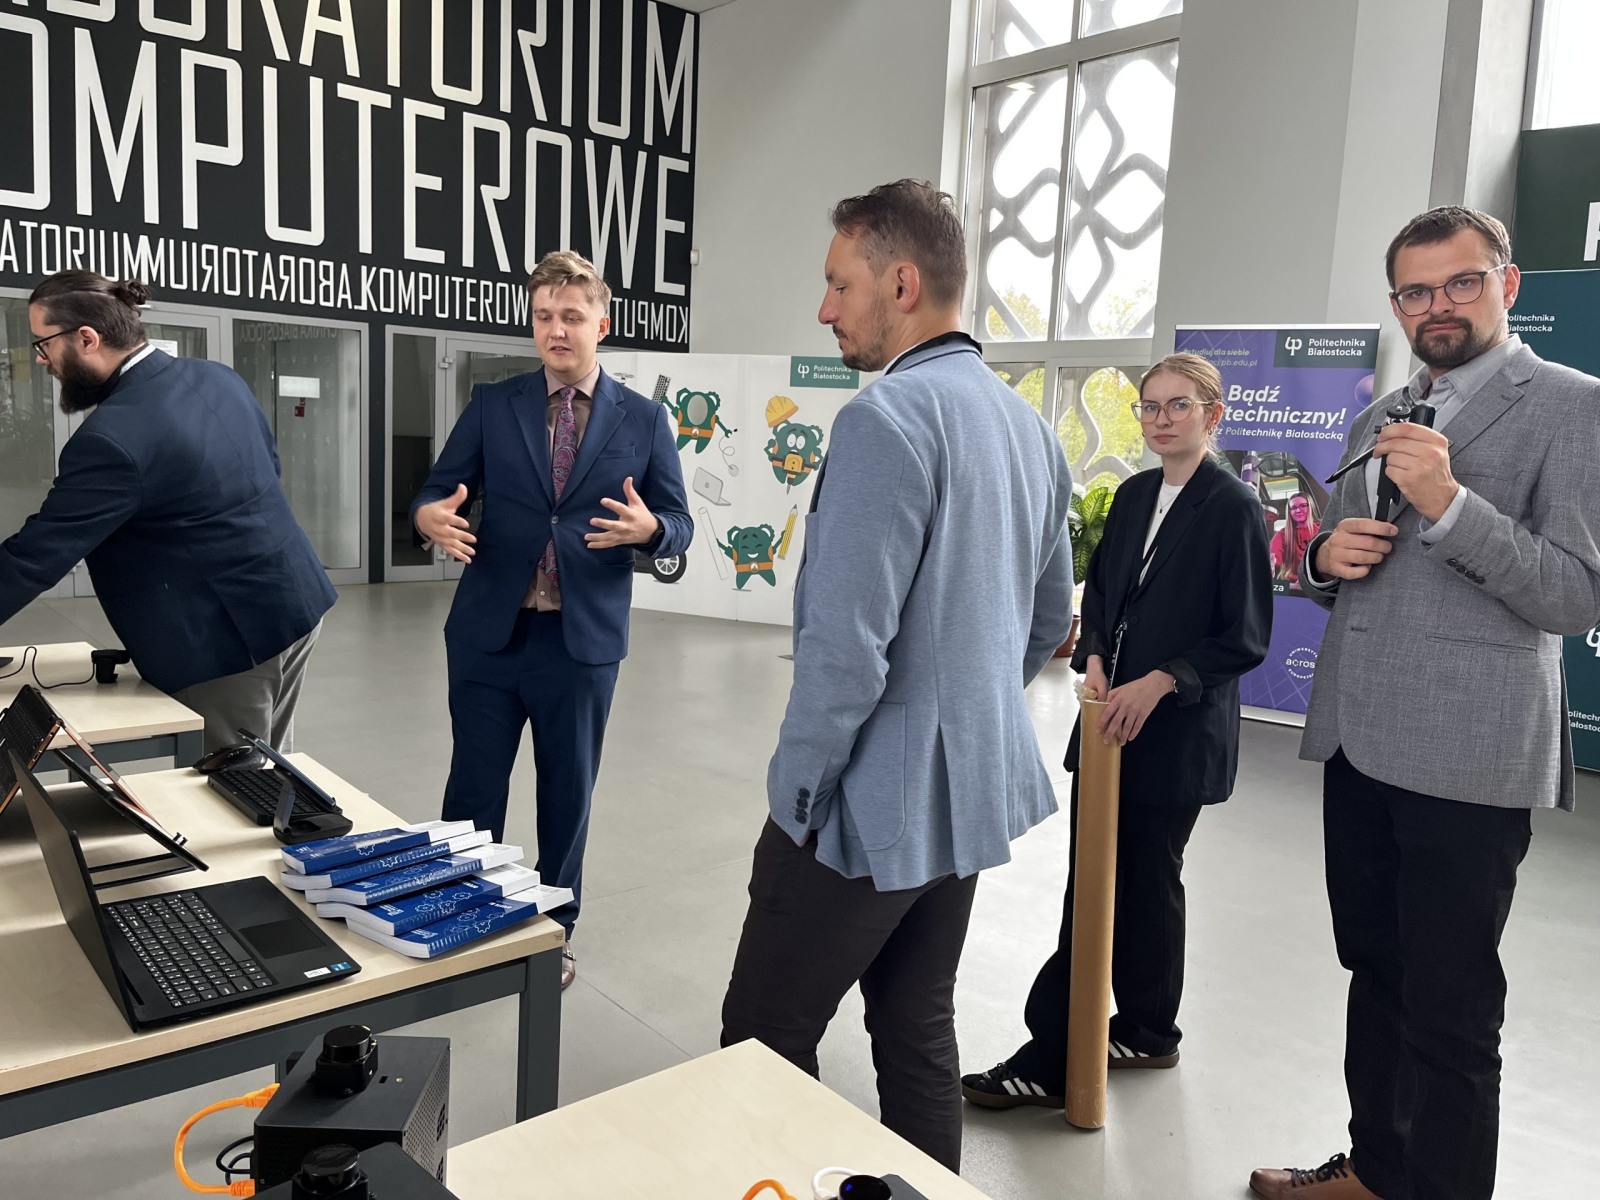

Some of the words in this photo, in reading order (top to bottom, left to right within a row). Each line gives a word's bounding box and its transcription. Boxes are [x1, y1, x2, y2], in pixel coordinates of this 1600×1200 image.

[360, 264, 534, 327] KOMPUTEROW
[1507, 313, 1555, 322] olitechnika
[1508, 324, 1553, 332] iałostocka
[1308, 338, 1366, 347] Politechnika
[1213, 348, 1227, 356] dla
[1227, 348, 1250, 356] siebie
[1307, 348, 1362, 356] Białostocka
[813, 365, 852, 373] Politechnika
[1227, 385, 1281, 406] Bądź
[1224, 405, 1347, 429] techniczny!
[1225, 427, 1283, 439] Politechnikę
[1285, 429, 1344, 442] Białostocką
